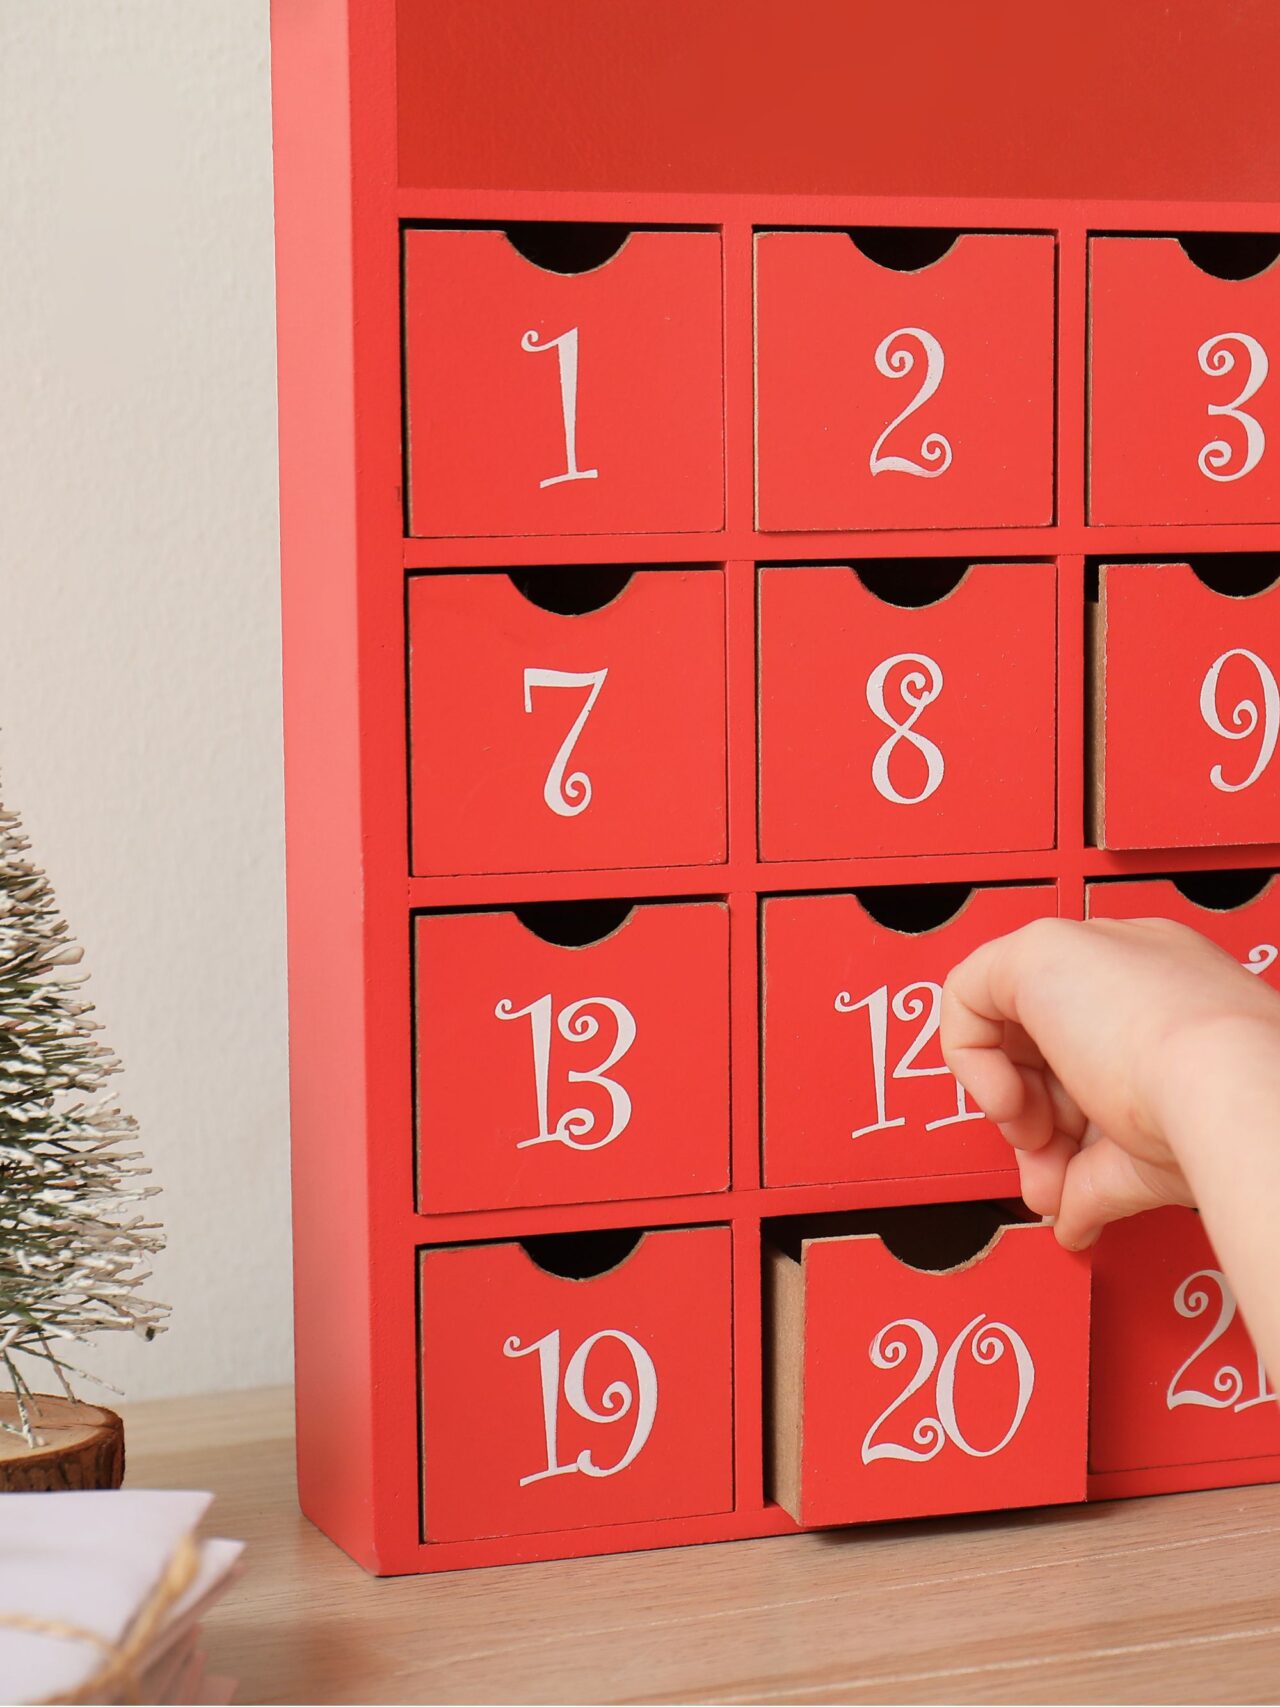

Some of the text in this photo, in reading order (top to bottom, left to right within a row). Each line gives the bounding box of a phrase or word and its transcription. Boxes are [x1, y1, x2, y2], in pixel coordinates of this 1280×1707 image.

[521, 328, 598, 488] 1
[870, 328, 952, 478] 2
[1198, 333, 1268, 482] 3
[524, 668, 609, 817] 7
[866, 654, 945, 805] 8
[1199, 649, 1280, 793] 9
[495, 993, 637, 1152] 13
[502, 1329, 658, 1487] 19
[861, 1314, 1035, 1465] 20
